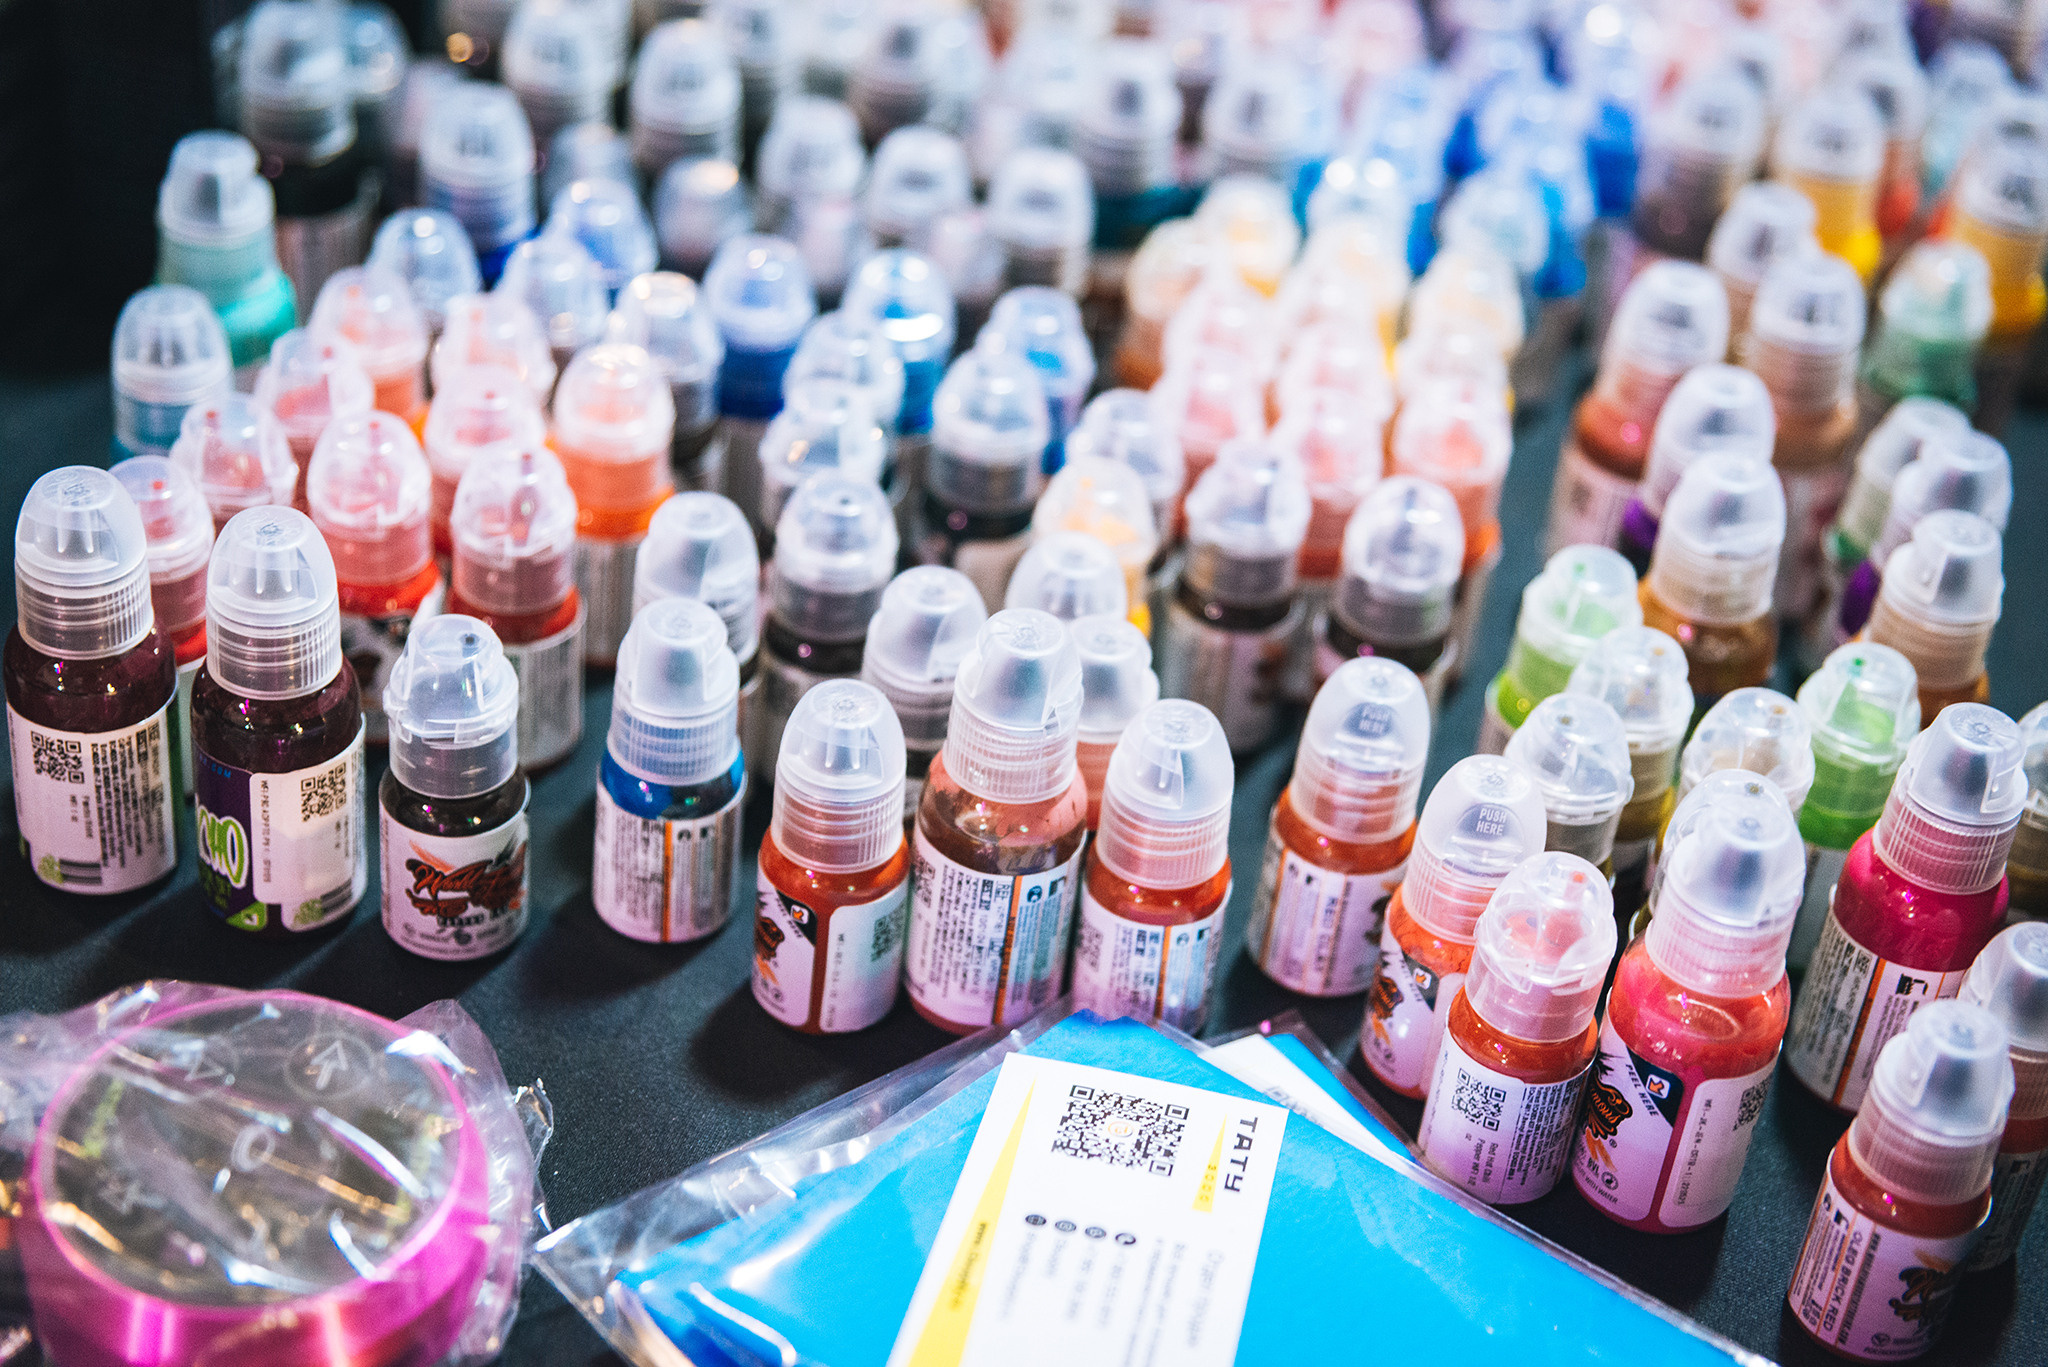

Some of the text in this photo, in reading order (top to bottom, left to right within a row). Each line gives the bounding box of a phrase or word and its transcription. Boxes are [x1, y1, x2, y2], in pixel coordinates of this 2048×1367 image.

[1476, 820, 1505, 836] HERE
[1479, 808, 1508, 824] PUSH
[1626, 1064, 1660, 1117] PEEL HERE
[1471, 1137, 1485, 1161] Pepper
[1488, 1142, 1498, 1155] Red
[1832, 1265, 1852, 1303] BRICK
[1822, 1304, 1839, 1331] RED
